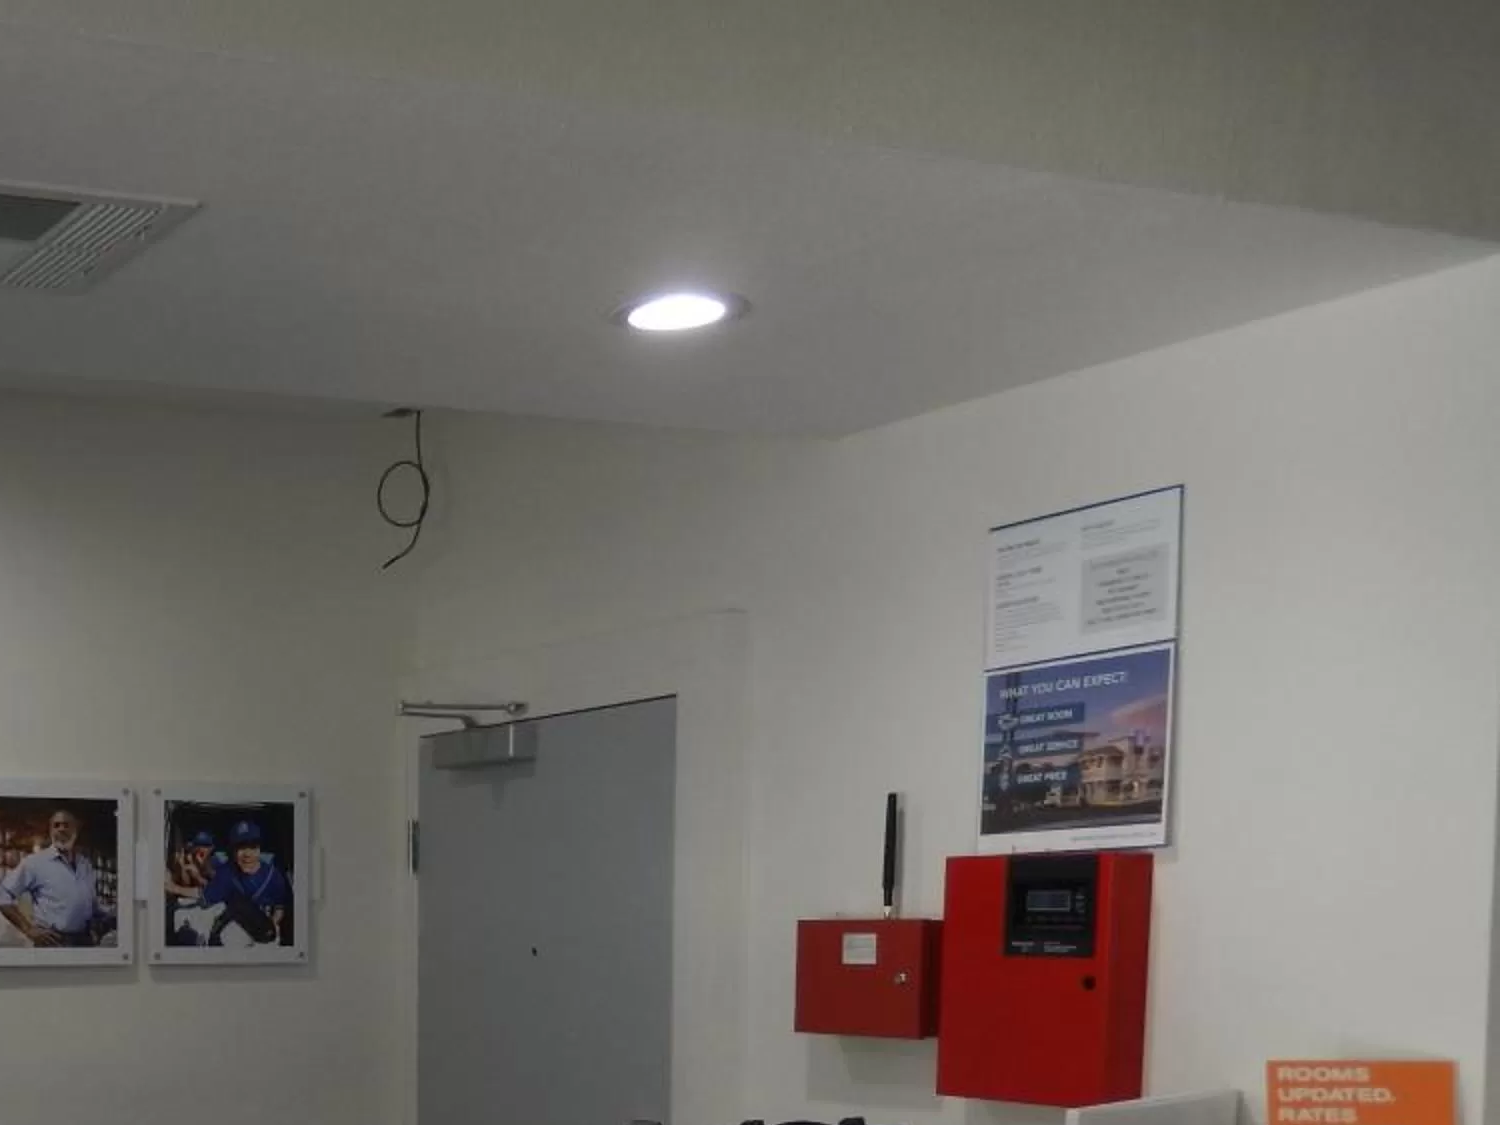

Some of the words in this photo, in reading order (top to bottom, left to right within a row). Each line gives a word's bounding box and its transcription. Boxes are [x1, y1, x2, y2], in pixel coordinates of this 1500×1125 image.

[1000, 684, 1028, 699] WHAT
[1032, 681, 1053, 695] YOU
[1056, 676, 1081, 692] CAN
[1277, 1066, 1371, 1083] ROOMS
[1277, 1087, 1397, 1105] UPDATED.
